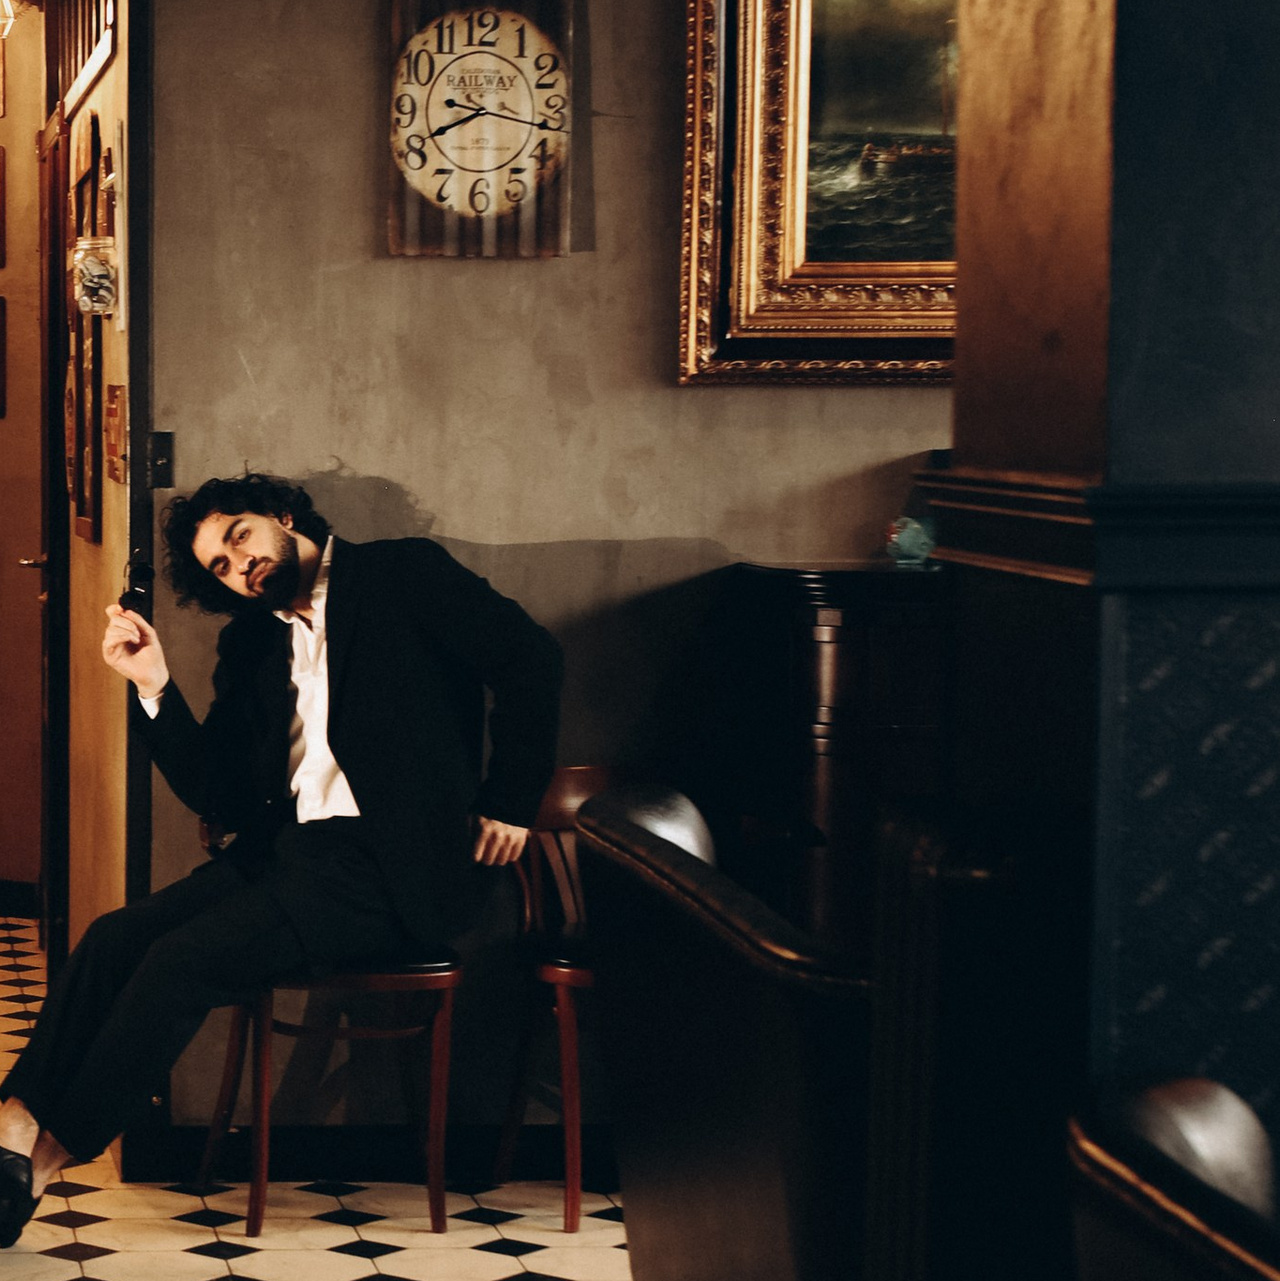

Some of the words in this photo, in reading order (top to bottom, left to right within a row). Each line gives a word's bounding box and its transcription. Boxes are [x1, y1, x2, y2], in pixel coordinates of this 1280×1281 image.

[434, 18, 456, 55] 11
[463, 11, 500, 47] 12
[514, 23, 528, 58] 1
[403, 49, 435, 86] 10
[446, 74, 518, 88] RAILWAY
[534, 53, 560, 89] 2
[395, 93, 417, 128] 9
[545, 94, 566, 131] 3
[405, 134, 427, 170] 8
[528, 138, 555, 170] 4
[432, 168, 455, 203] 7
[469, 178, 490, 214] 6
[505, 167, 527, 203] 5
